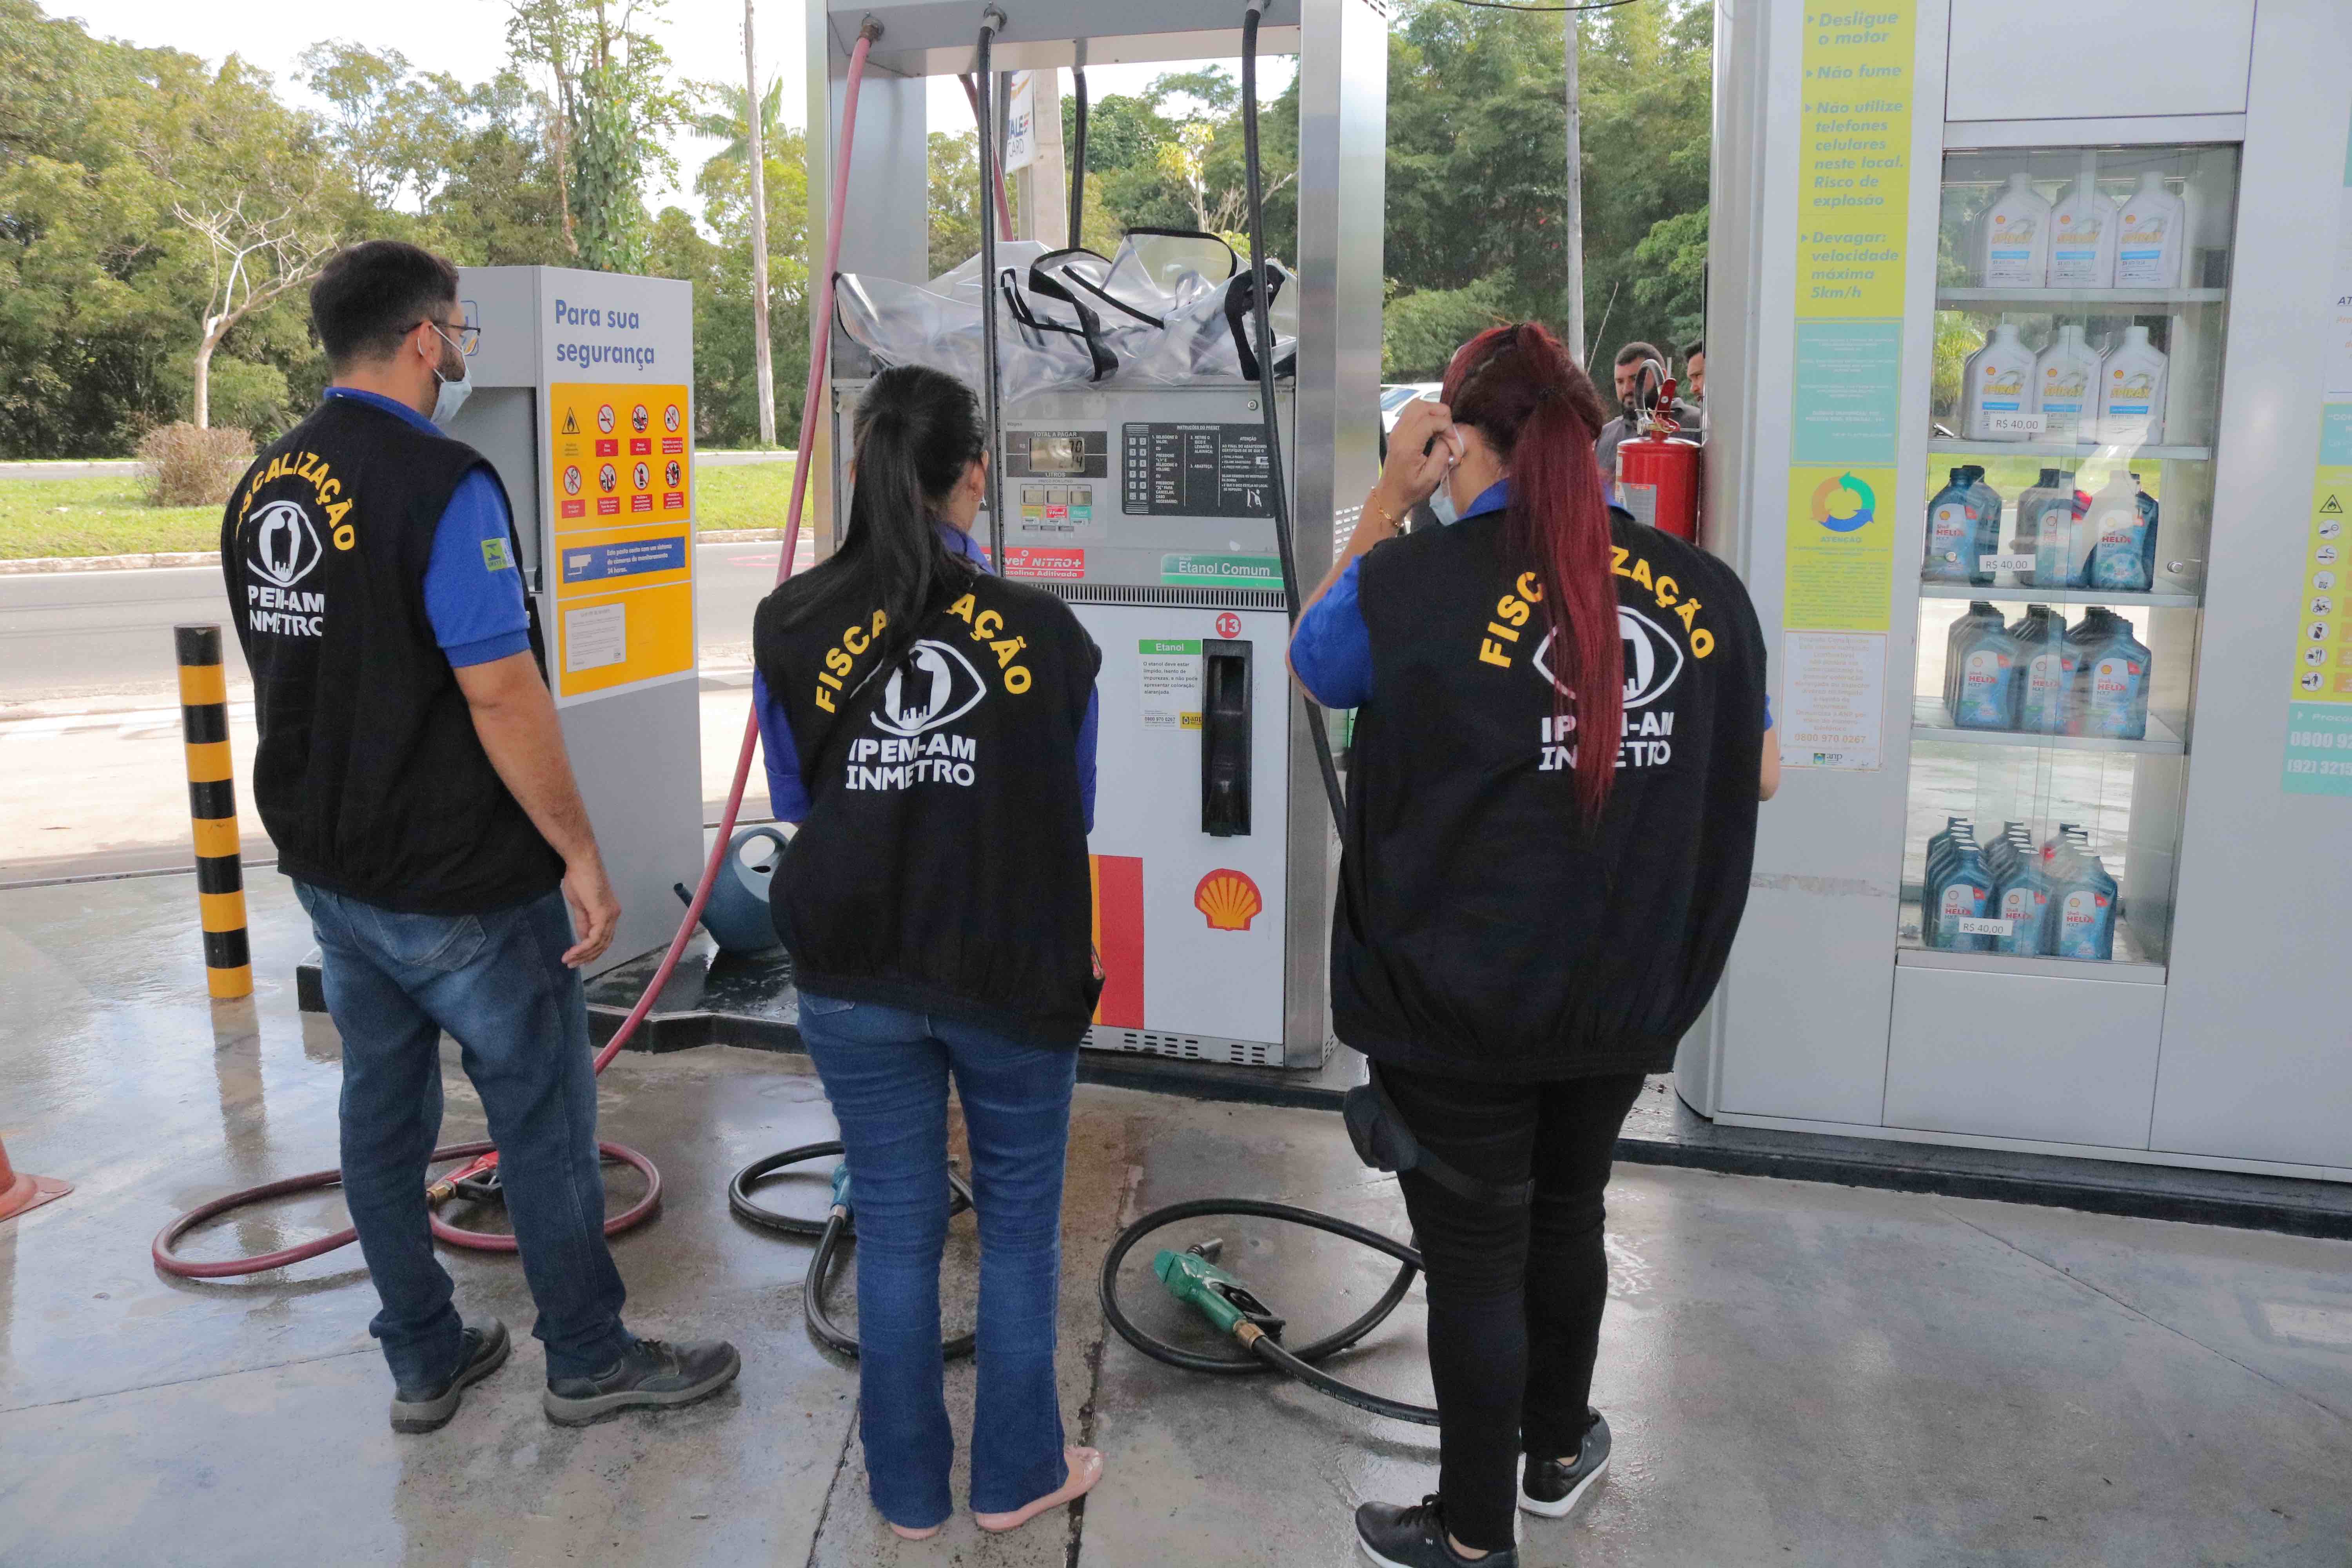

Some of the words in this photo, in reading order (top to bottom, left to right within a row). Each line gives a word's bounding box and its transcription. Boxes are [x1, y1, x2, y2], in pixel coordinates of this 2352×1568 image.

[1819, 11, 1898, 28] Desligue
[1819, 35, 1829, 45] o
[1835, 31, 1889, 44] motor
[1818, 65, 1853, 78] Não
[1859, 64, 1901, 77] fume
[1817, 102, 1849, 113] Não
[1855, 100, 1903, 113] utilize
[1815, 119, 1887, 132] telefones
[1007, 139, 1024, 157] CARD
[1815, 138, 1886, 151] celulares
[1815, 158, 1856, 169] neste
[1862, 154, 1903, 168] local.
[1814, 176, 1853, 188] Risco
[1859, 174, 1878, 187] de
[1813, 194, 1884, 209] explosão
[1812, 232, 1887, 246] Devagar:
[1811, 249, 1898, 261] velocidade
[1811, 267, 1875, 279] máxima
[1811, 285, 1861, 299] 5km/h
[555, 299, 601, 327] Para
[608, 311, 639, 328] sua
[557, 343, 655, 371] segurança
[1996, 419, 2007, 430] R$
[2011, 420, 2038, 430] 40,00
[1179, 561, 1217, 573] Etanol
[1222, 563, 1270, 576] Comum
[1986, 561, 1998, 570] R$
[2000, 560, 2027, 570] 40,00
[1218, 618, 1239, 633] 13
[1822, 734, 1839, 743] 970
[1842, 735, 1866, 743] 0267
[2290, 731, 2333, 746] 0800
[848, 733, 976, 762] IPEM-AM
[846, 759, 975, 791] INMETRO
[1964, 923, 1975, 931] R$
[1977, 924, 2004, 934] 40,00
